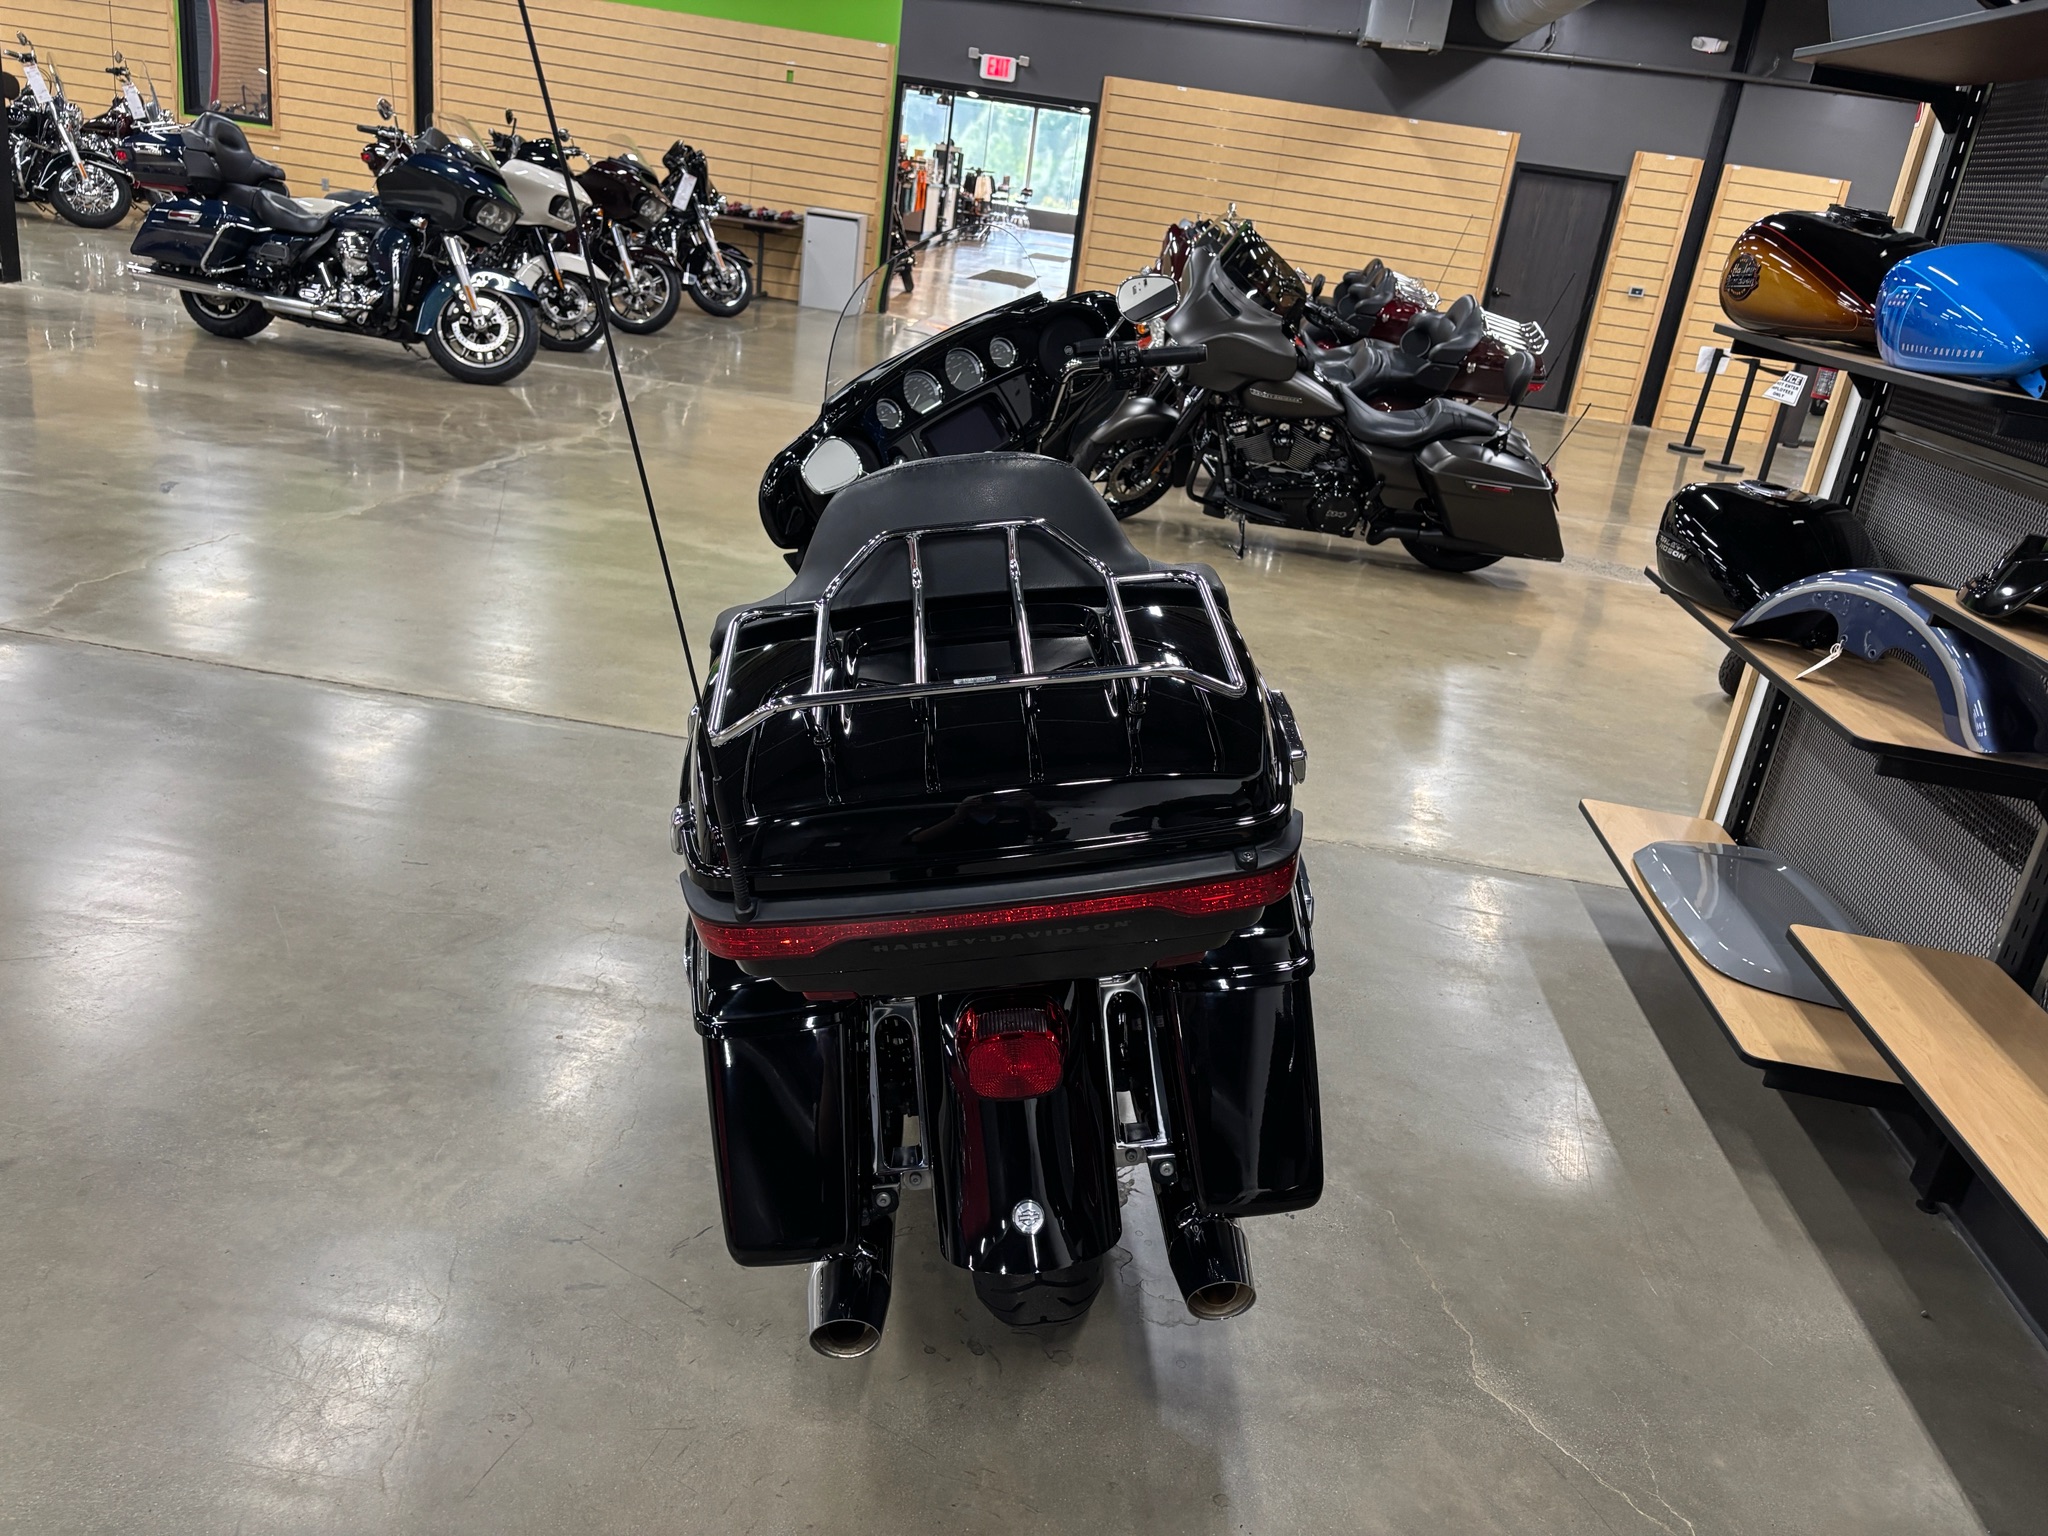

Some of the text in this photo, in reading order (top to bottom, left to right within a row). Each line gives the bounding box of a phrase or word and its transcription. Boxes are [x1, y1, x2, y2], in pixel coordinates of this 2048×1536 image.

[987, 57, 1011, 77] EXIT
[1901, 343, 1984, 358] HARLEY-DAVIDSON
[873, 920, 1130, 952] HARLEY-DAVIDSON
